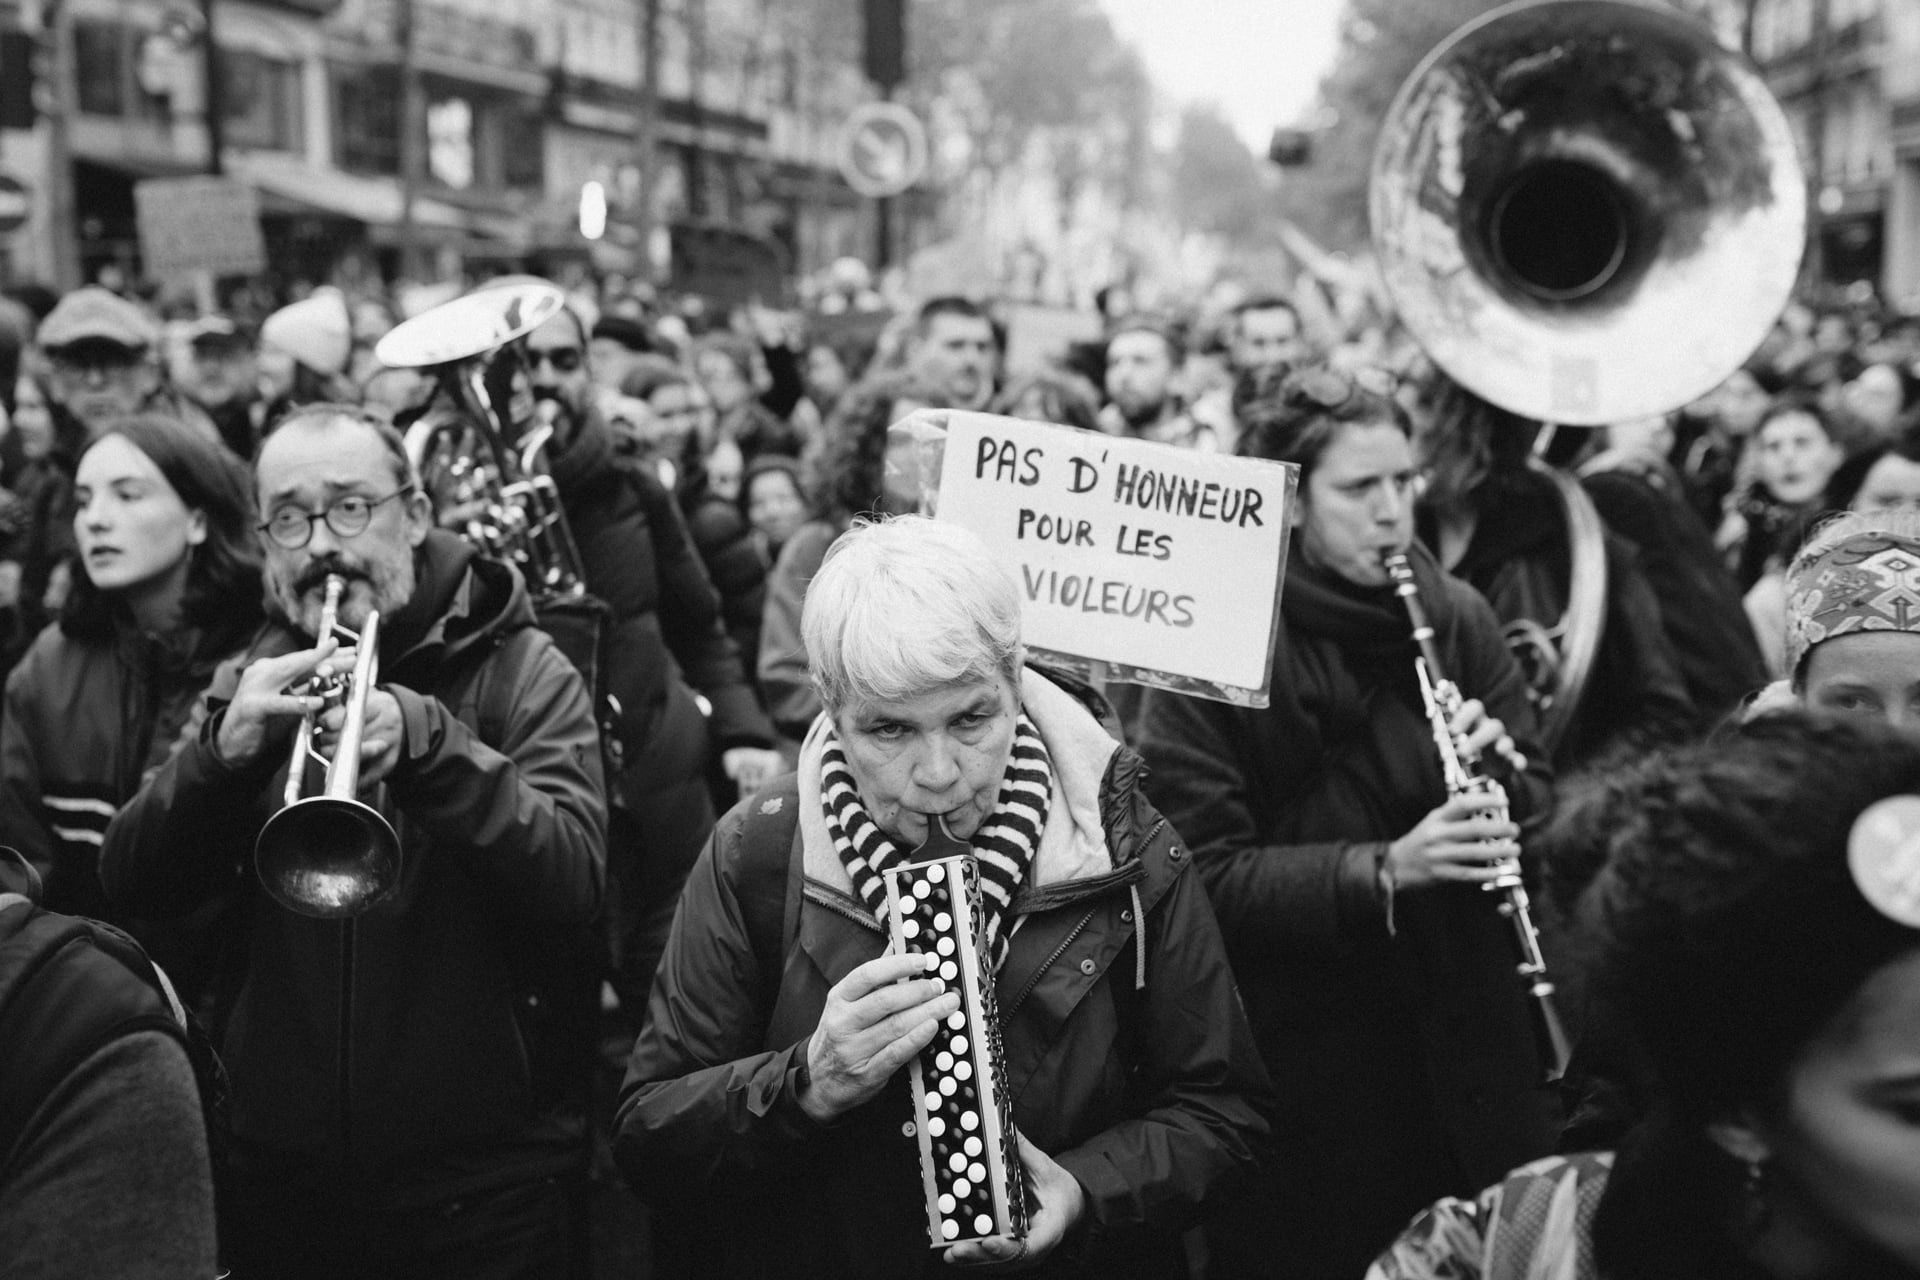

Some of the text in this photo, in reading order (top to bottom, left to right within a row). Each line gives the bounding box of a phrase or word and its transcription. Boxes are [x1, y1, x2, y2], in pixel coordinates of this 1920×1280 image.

[976, 436, 1043, 486] PAS
[1018, 508, 1173, 560] POUR LES
[1021, 563, 1196, 629] VIOLEURS
